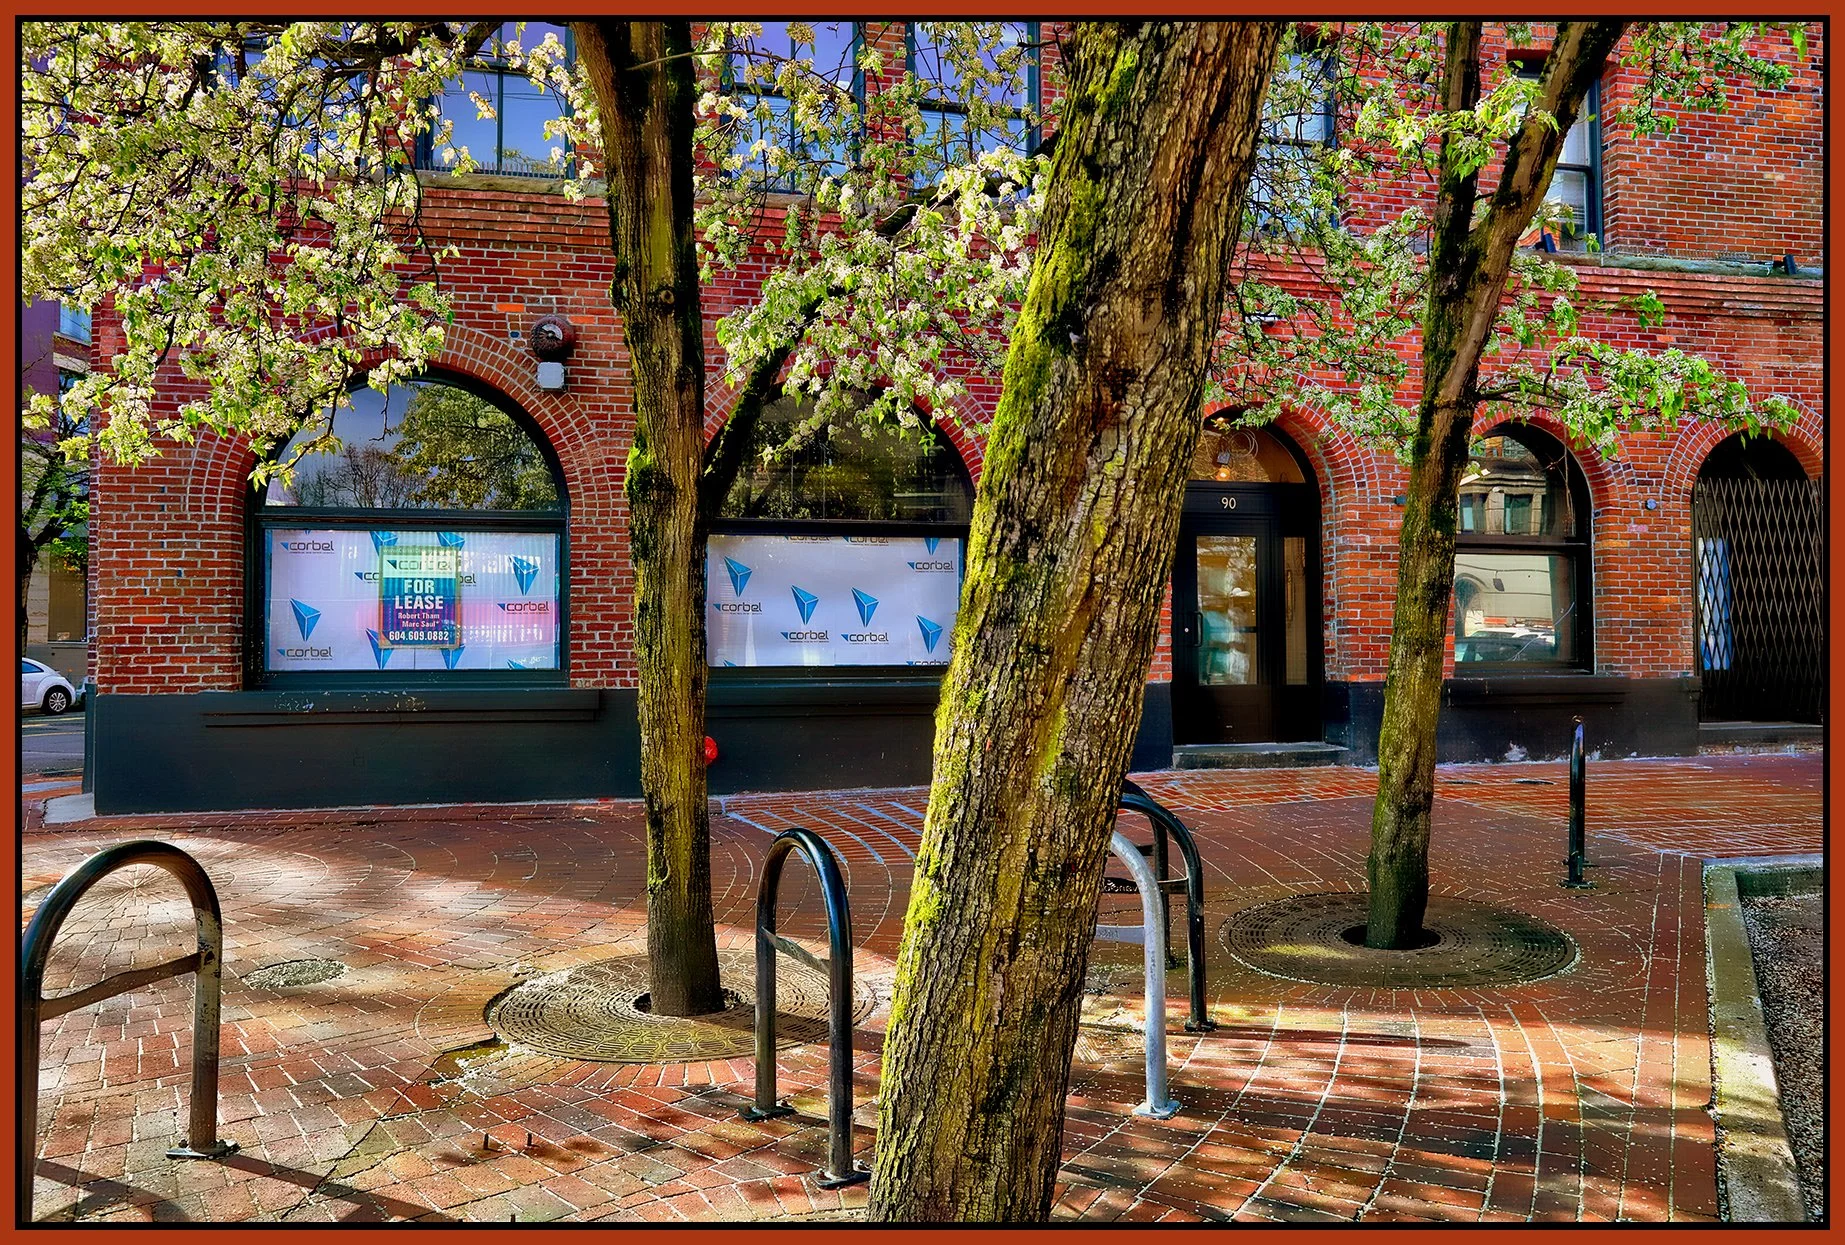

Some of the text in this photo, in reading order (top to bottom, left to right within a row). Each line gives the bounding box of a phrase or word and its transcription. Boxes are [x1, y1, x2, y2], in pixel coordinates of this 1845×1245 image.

[1221, 497, 1237, 509] 90
[289, 540, 334, 551] corbel
[915, 561, 954, 571] corbel
[404, 579, 435, 594] FOR
[395, 595, 444, 610] LEASE
[506, 601, 549, 612] corbel
[721, 602, 762, 612] corbel
[388, 631, 449, 641] 604.609.0882
[789, 630, 829, 640] corbel
[849, 632, 888, 642] corbel
[286, 646, 333, 657] corbel
